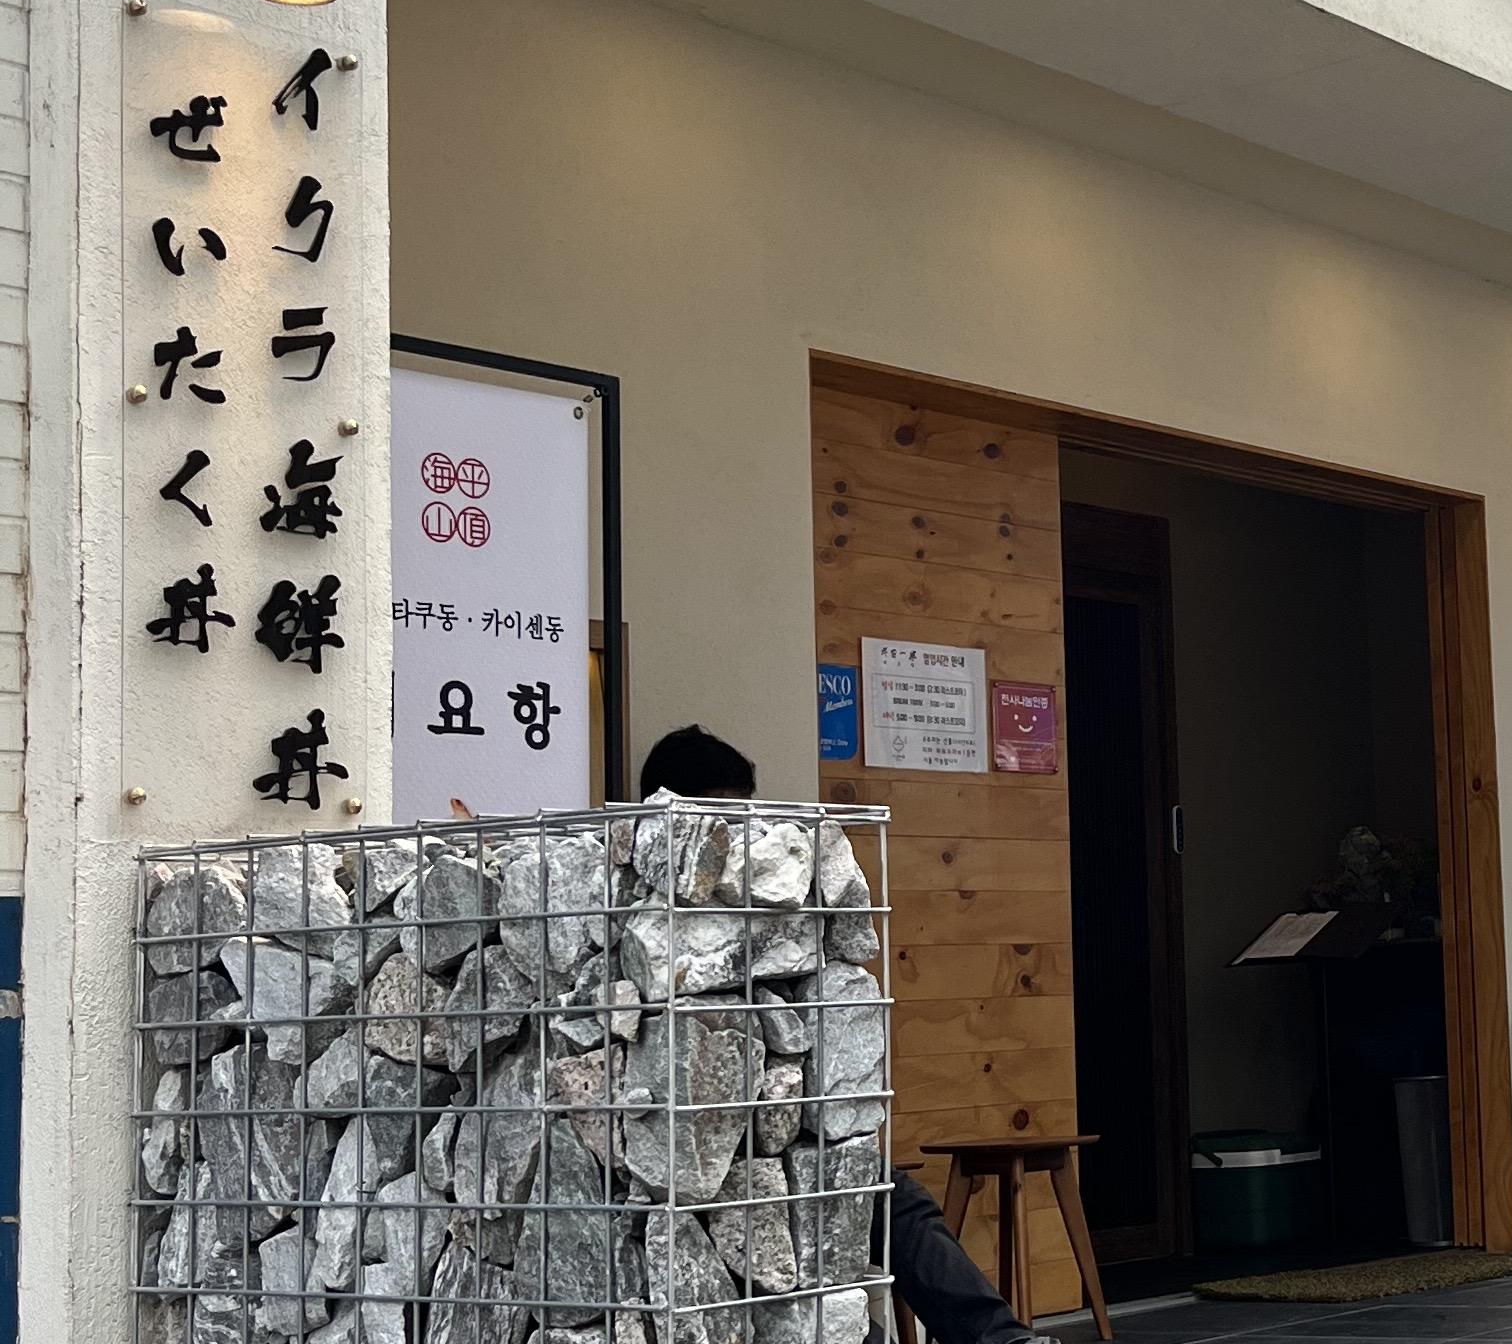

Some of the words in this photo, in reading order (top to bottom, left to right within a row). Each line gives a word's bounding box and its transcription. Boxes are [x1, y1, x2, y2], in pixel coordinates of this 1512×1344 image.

[146, 94, 237, 654] ぜいたく丼
[252, 48, 349, 810] イクラ海鮮丼
[481, 608, 565, 643] 카이센동
